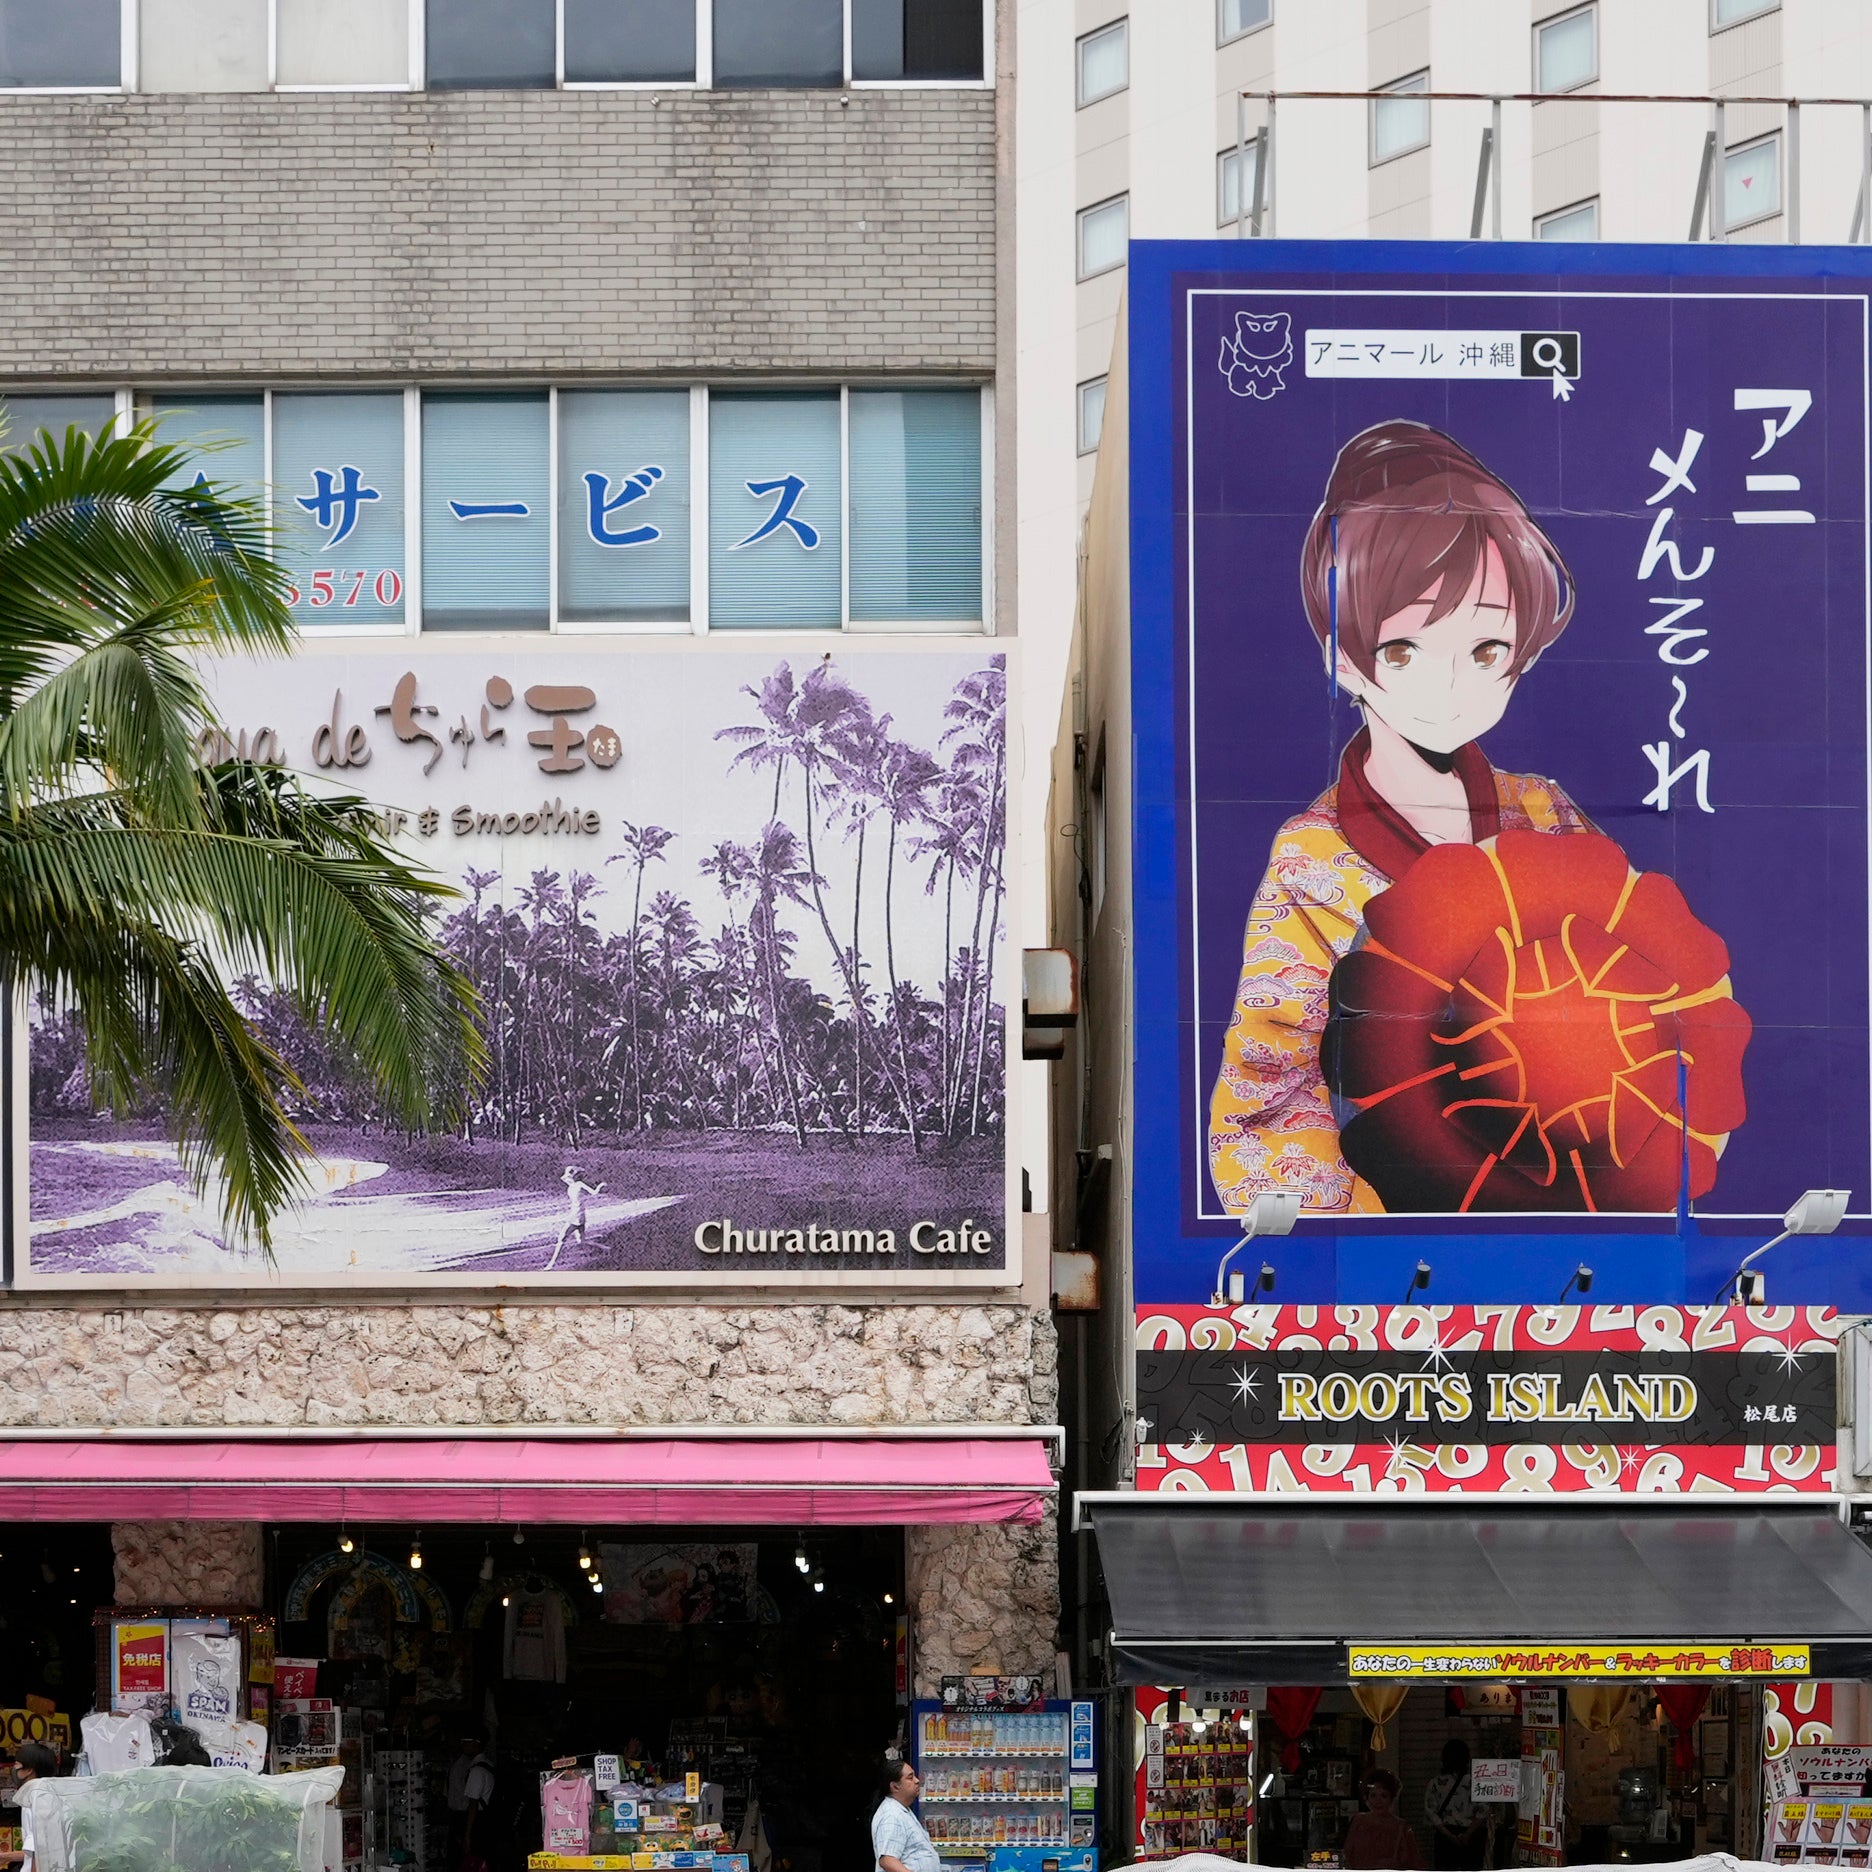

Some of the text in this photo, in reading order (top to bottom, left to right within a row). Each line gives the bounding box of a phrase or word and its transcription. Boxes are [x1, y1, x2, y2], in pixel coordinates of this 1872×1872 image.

[1309, 340, 1517, 369] アニマール 沖縄
[1731, 388, 1817, 525] アニ
[311, 687, 373, 769] de
[449, 797, 601, 837] Smoothie
[693, 1218, 992, 1255] Churatama Cafe
[1277, 1371, 1698, 1424] ROOTS ISLAND
[1743, 1403, 1798, 1425] 松尾店
[122, 1652, 162, 1667] 免税店
[188, 1695, 230, 1715] SPAM
[597, 1757, 617, 1766] SHOP
[1820, 1747, 1862, 1756] あなたの
[598, 1765, 613, 1773] TAX
[1799, 1757, 1872, 1768] ソウルナンバ
[598, 1773, 617, 1781] FREE
